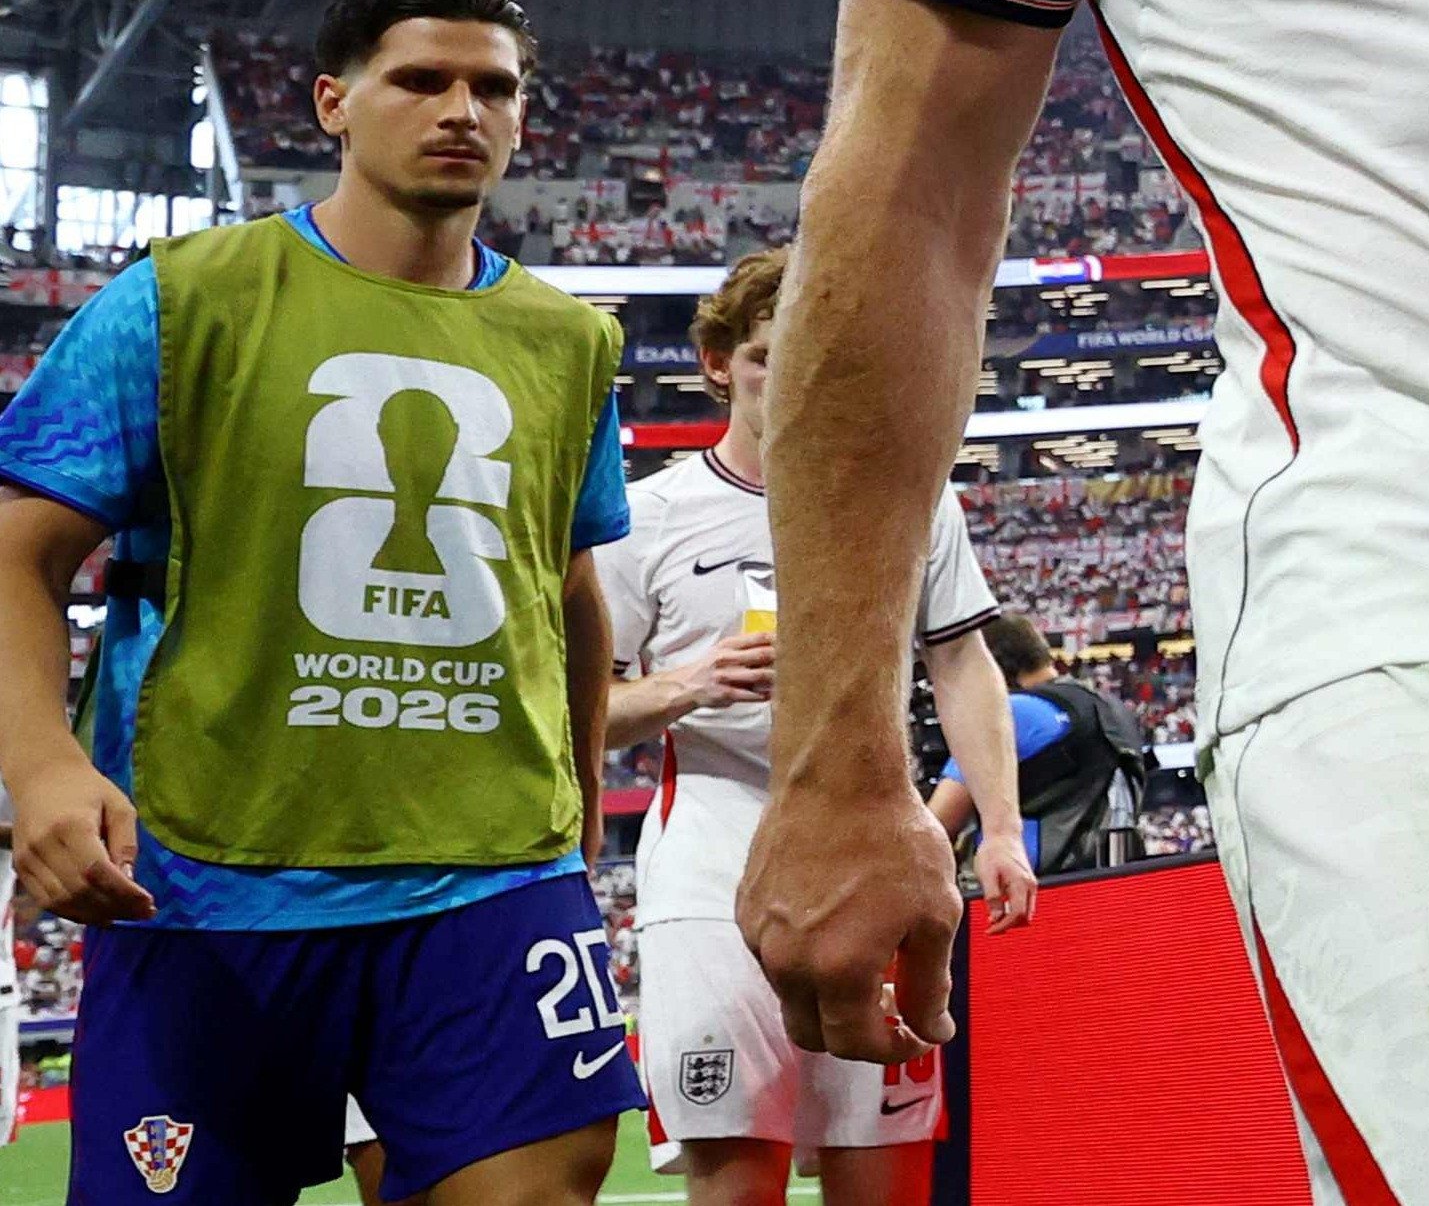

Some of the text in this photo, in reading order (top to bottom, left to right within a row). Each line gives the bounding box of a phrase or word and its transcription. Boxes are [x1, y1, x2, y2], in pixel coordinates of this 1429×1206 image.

[363, 584, 451, 620] FIFA
[294, 652, 505, 686] WORLD CUP
[287, 685, 500, 734] 2026
